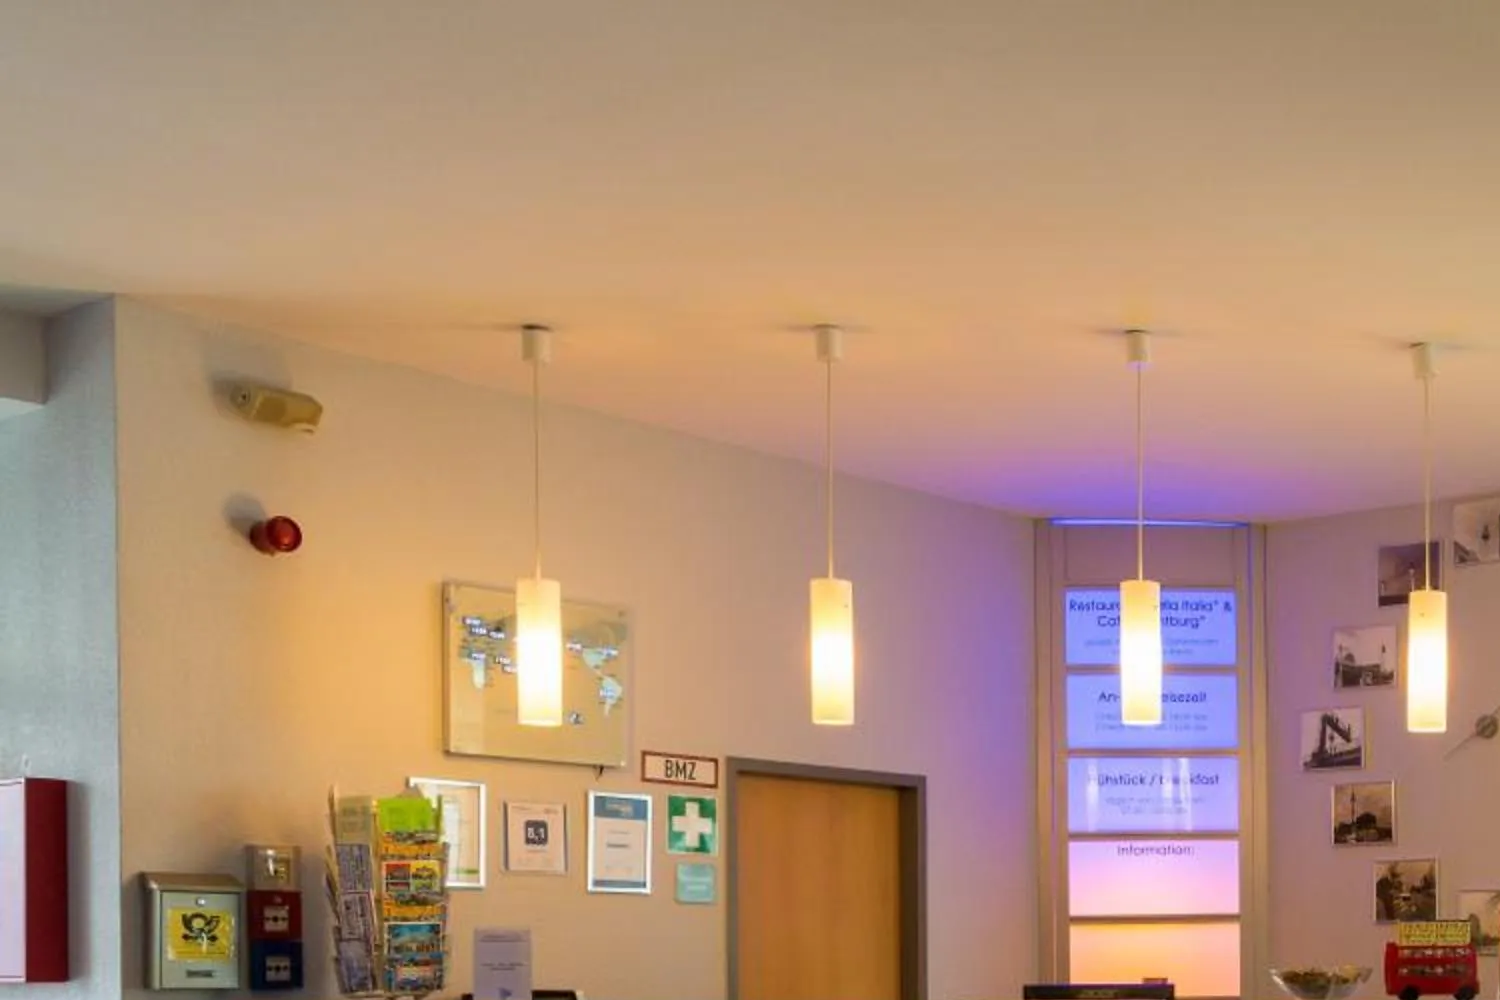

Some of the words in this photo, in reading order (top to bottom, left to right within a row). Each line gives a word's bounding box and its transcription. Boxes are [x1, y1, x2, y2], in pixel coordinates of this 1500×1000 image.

[1069, 599, 1121, 612] Restaur
[1097, 615, 1121, 628] Caf
[664, 759, 697, 780] BMZ
